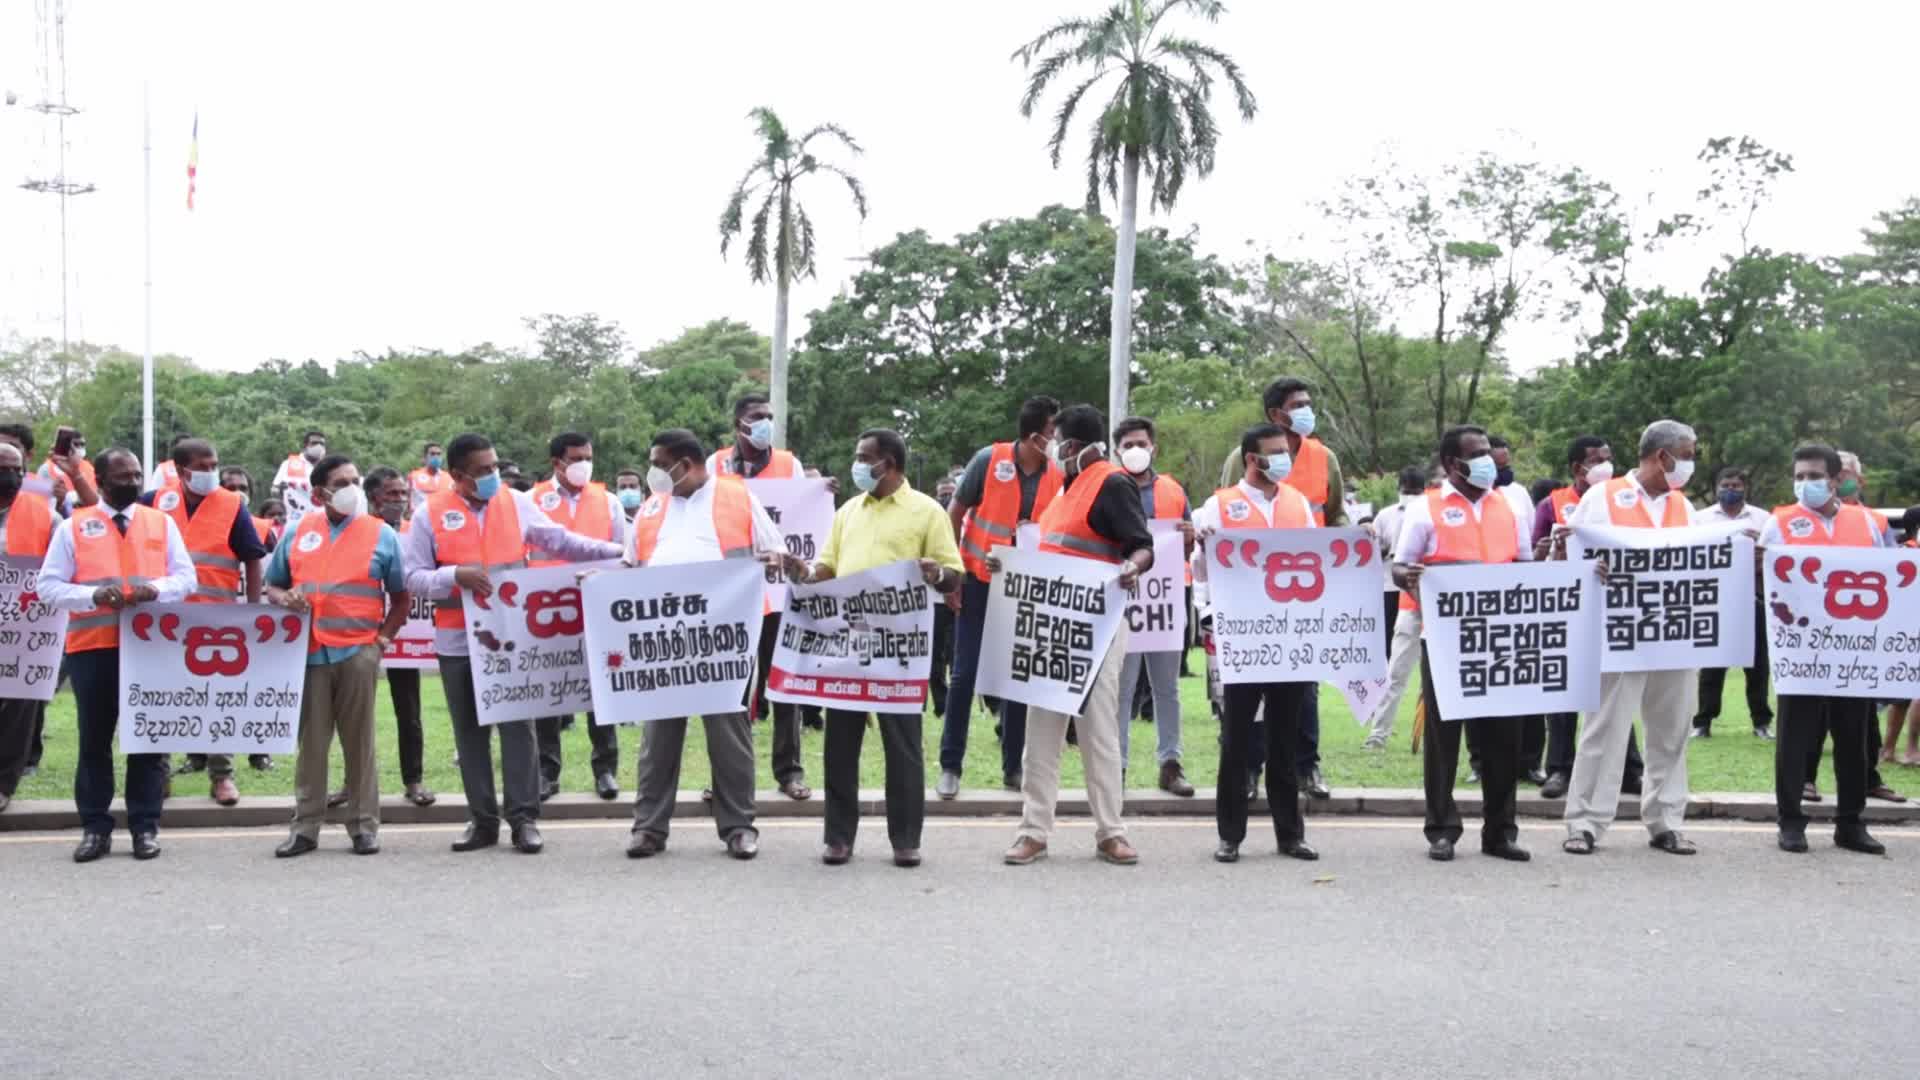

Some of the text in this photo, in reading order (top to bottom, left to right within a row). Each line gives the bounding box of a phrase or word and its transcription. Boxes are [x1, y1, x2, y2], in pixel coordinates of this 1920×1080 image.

[610, 592, 709, 623] பேச்சு
[1004, 571, 1105, 615] භාෂණයේ
[1146, 577, 1173, 600] OF
[1437, 578, 1582, 617] භාෂණයේ
[1606, 574, 1719, 616] නිදහස
[1014, 601, 1094, 651] නිදහස
[1329, 607, 1376, 634] වෙන්න
[1459, 618, 1567, 660] නිදහස
[1606, 606, 1719, 651] සුරකිමු
[628, 620, 750, 664] சுதந்திரத்தை
[1289, 643, 1313, 671] ඉඩ
[1011, 643, 1093, 694] සුරකිමු
[1459, 649, 1567, 697] සුරකිමු
[253, 681, 298, 708] වෙන්න
[209, 716, 236, 743] ඉඩ
